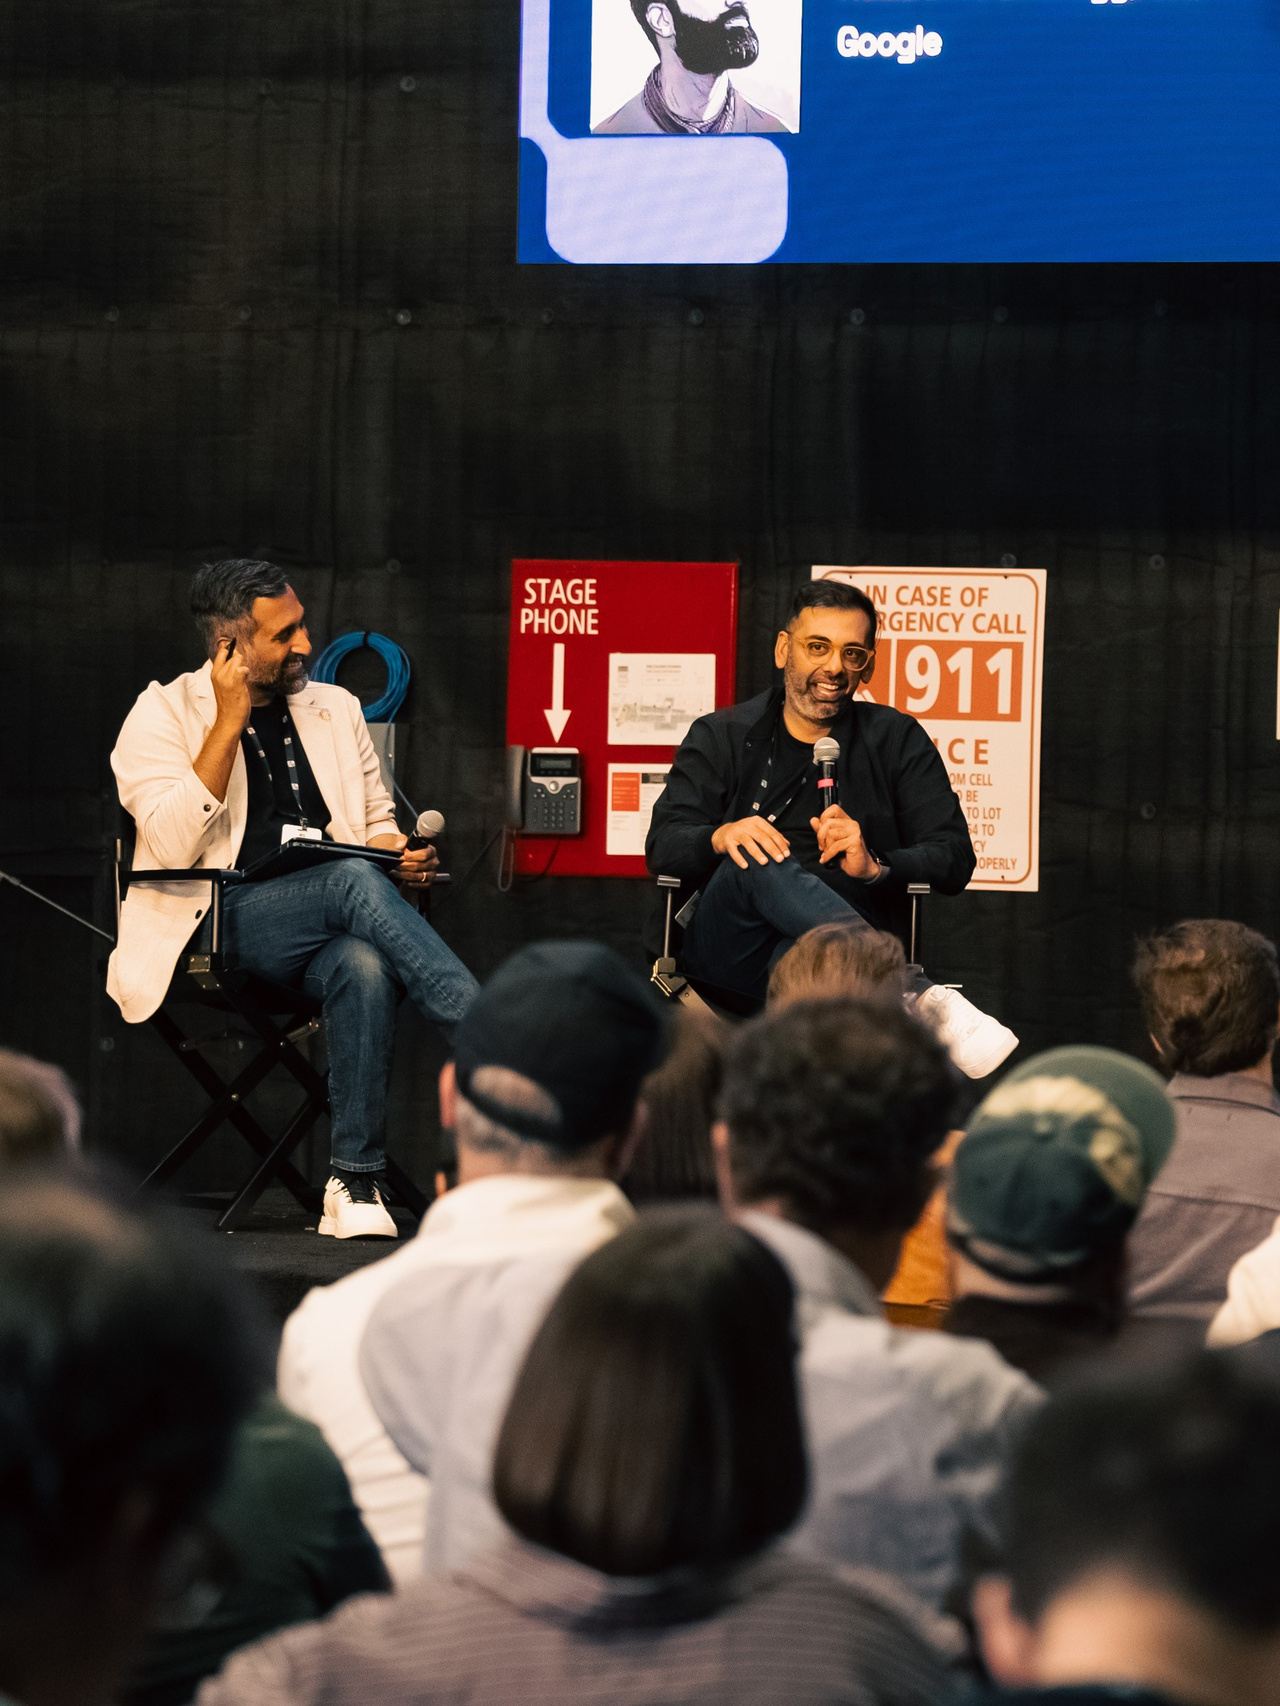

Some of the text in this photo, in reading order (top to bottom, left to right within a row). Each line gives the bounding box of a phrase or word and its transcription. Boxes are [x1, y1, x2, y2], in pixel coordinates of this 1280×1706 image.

[836, 24, 943, 64] Google
[524, 577, 597, 605] STAGE
[895, 584, 952, 607] CASE
[959, 586, 989, 608] OF
[520, 607, 599, 635] PHONE
[876, 611, 1027, 635] RGENCY CALL
[905, 644, 1013, 715] 911
[949, 772, 993, 787] OM CELL
[966, 790, 979, 803] BE
[966, 806, 1002, 820] TO LOT
[981, 824, 995, 837] TO
[976, 857, 1017, 871] OPERLY
